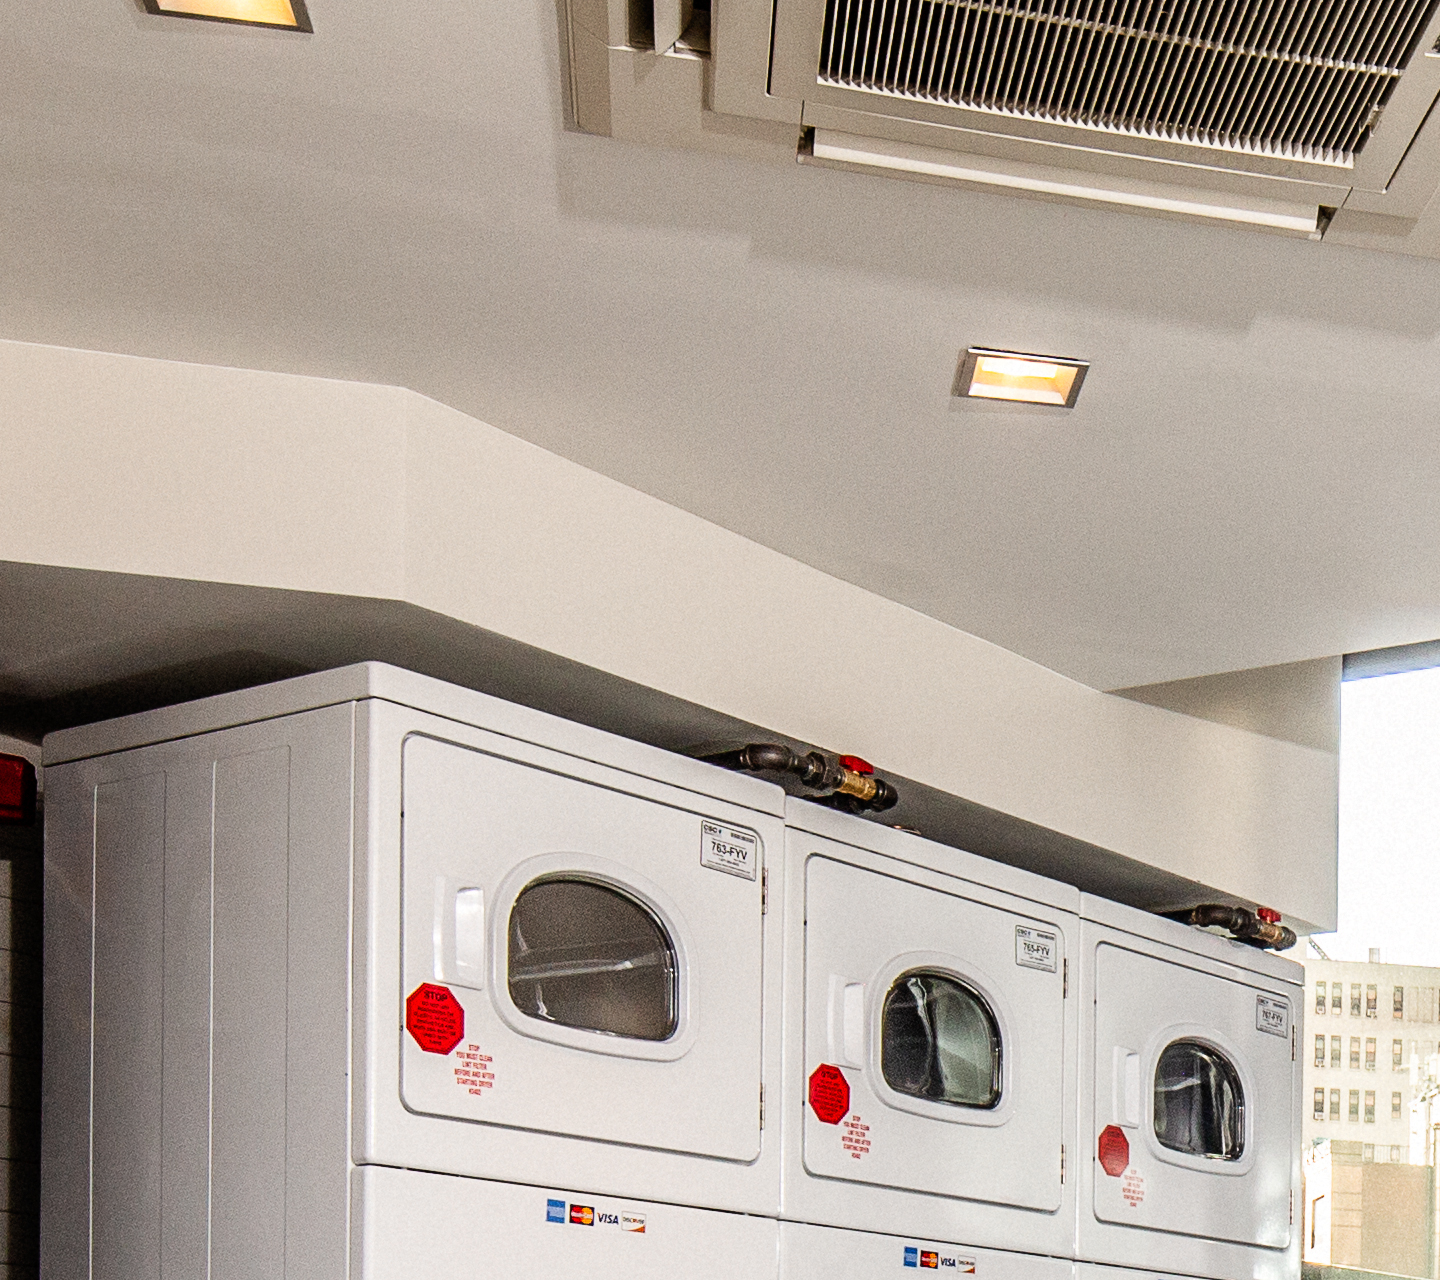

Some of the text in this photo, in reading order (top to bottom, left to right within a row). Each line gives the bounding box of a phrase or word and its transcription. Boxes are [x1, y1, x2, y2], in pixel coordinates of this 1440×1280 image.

[711, 840, 747, 860] 763-FYV
[597, 1212, 619, 1225] VISA
[940, 1256, 956, 1267] VISA
